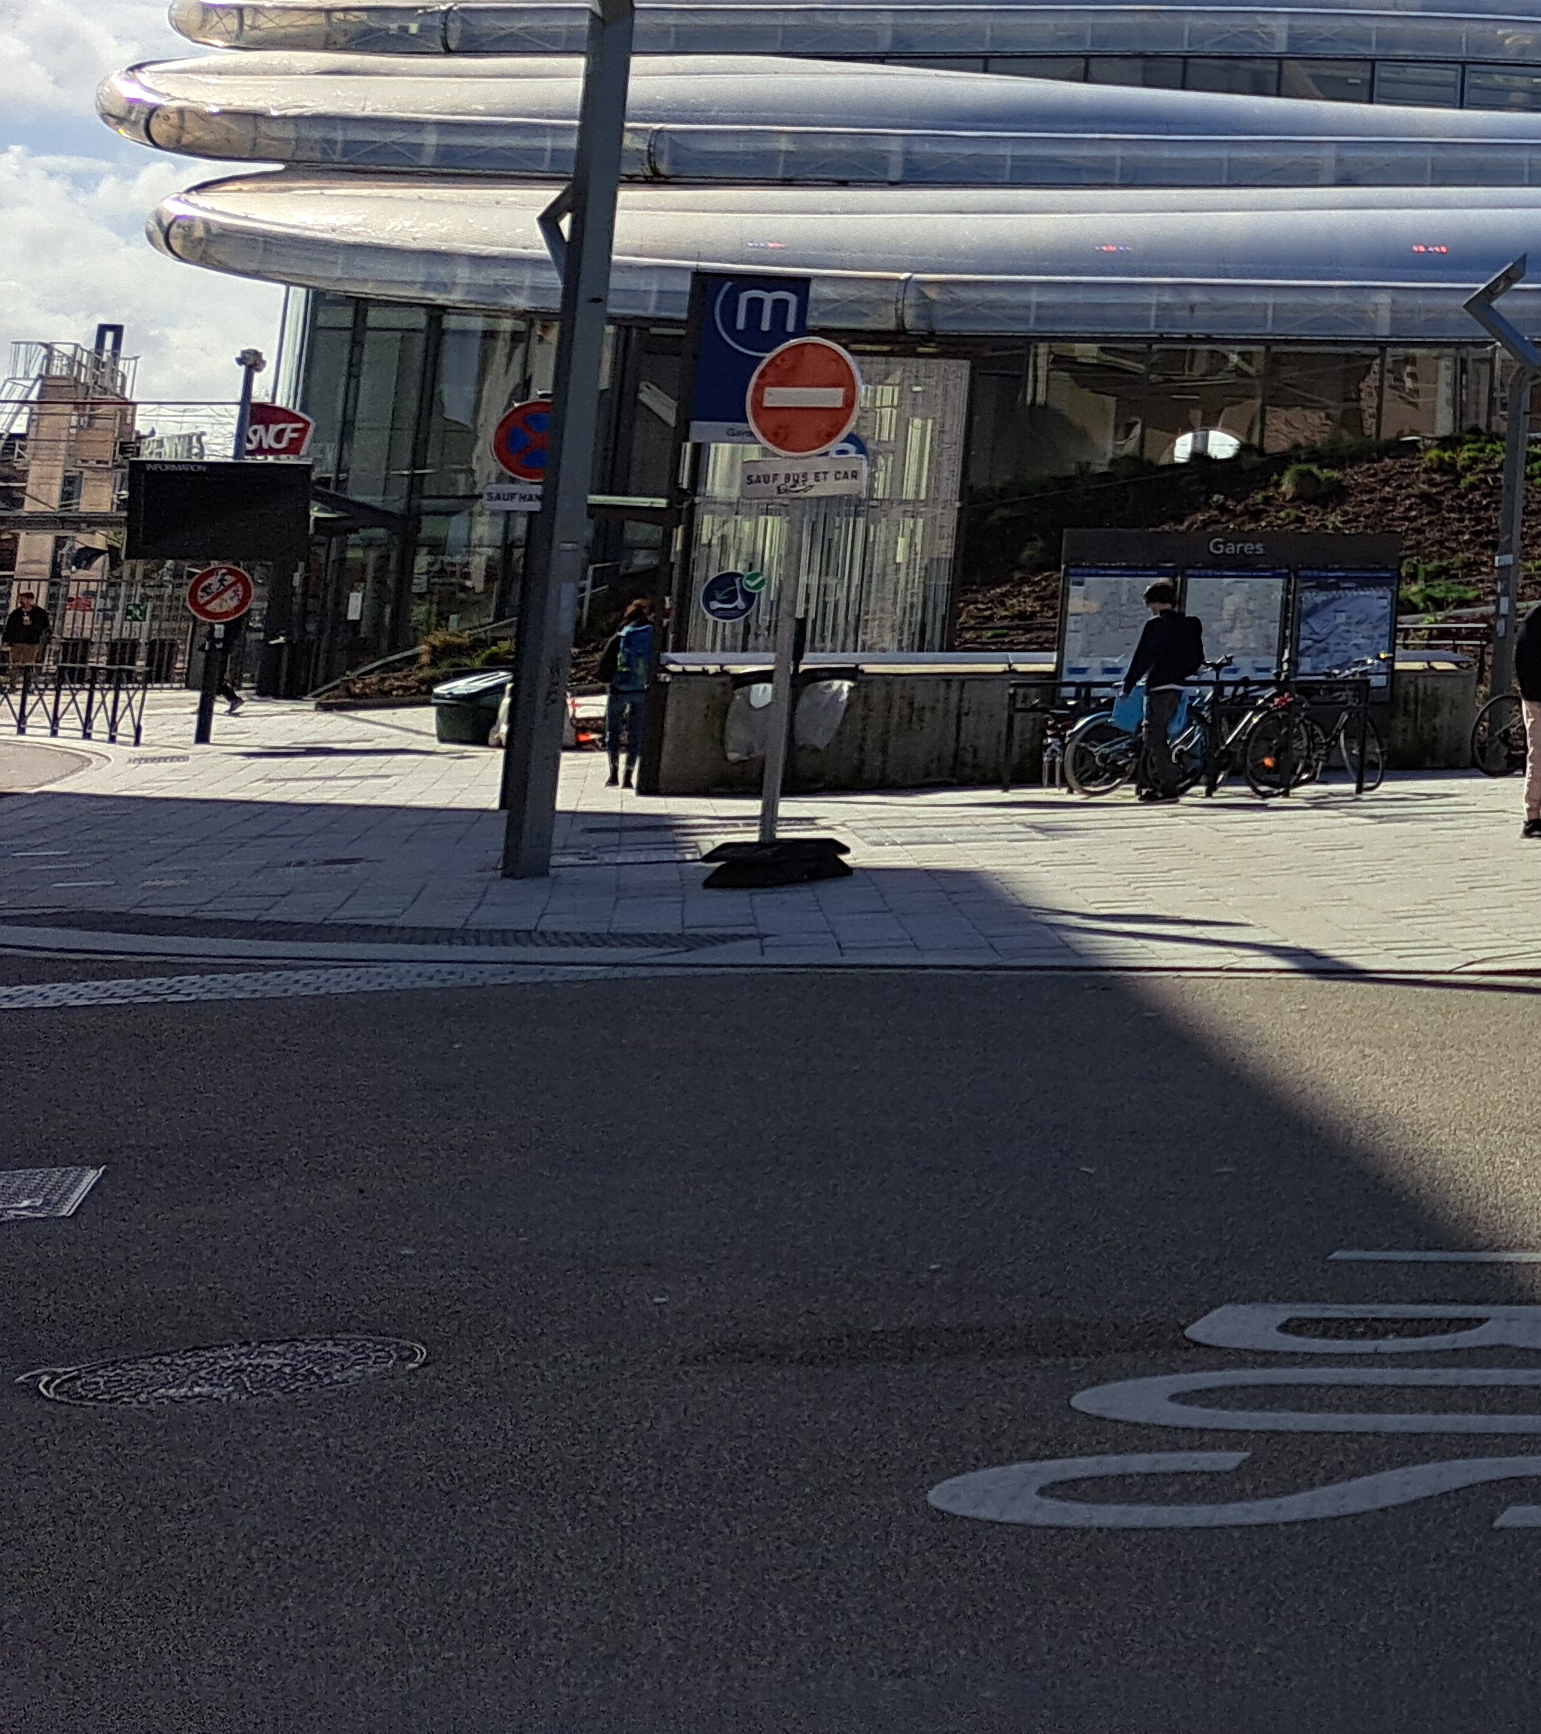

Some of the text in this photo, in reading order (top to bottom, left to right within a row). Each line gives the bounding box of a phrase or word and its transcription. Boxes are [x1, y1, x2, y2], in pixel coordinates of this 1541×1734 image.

[735, 288, 798, 333] m
[246, 423, 305, 450] SNCF
[144, 463, 207, 472] INFORMATION
[746, 469, 859, 486] SAUF BUS ET CAR
[486, 491, 544, 502] SAUF HAN
[1208, 537, 1266, 556] Gares
